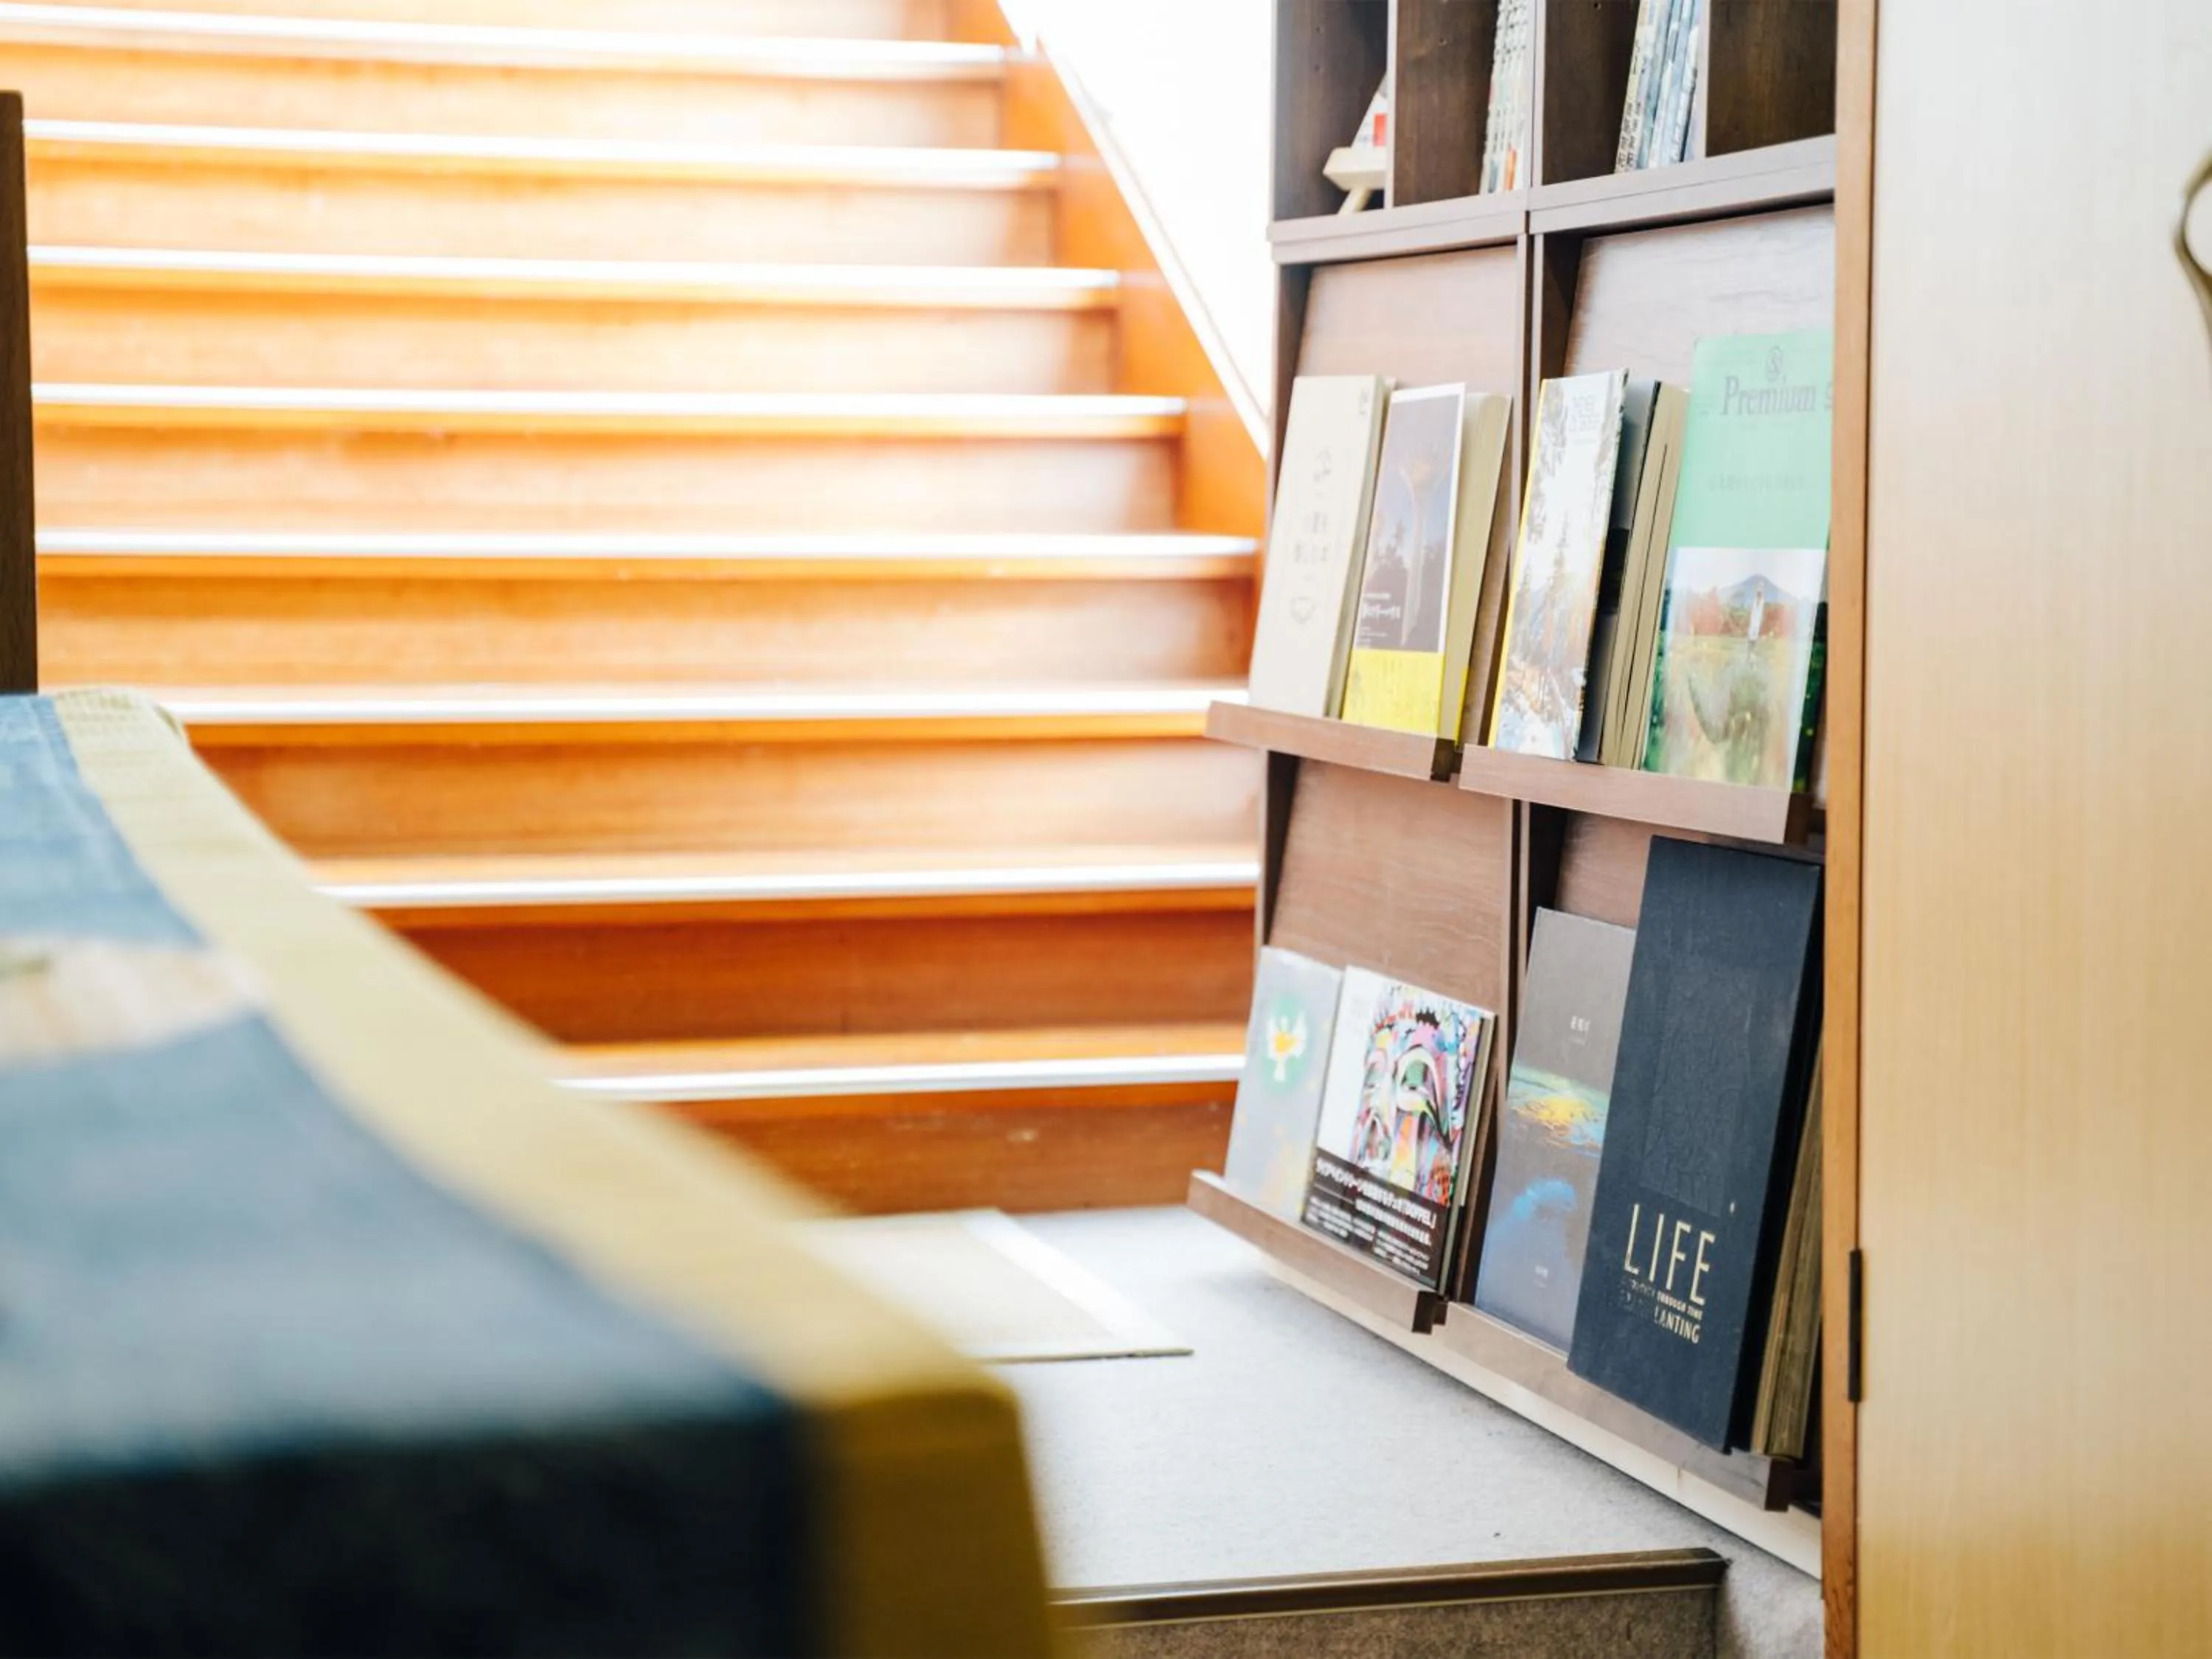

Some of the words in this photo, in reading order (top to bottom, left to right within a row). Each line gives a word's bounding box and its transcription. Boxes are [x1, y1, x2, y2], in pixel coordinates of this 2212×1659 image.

[1719, 375, 1816, 415] Premium
[1624, 1203, 1716, 1306] LIFE
[1654, 1306, 1700, 1343] LANTING
